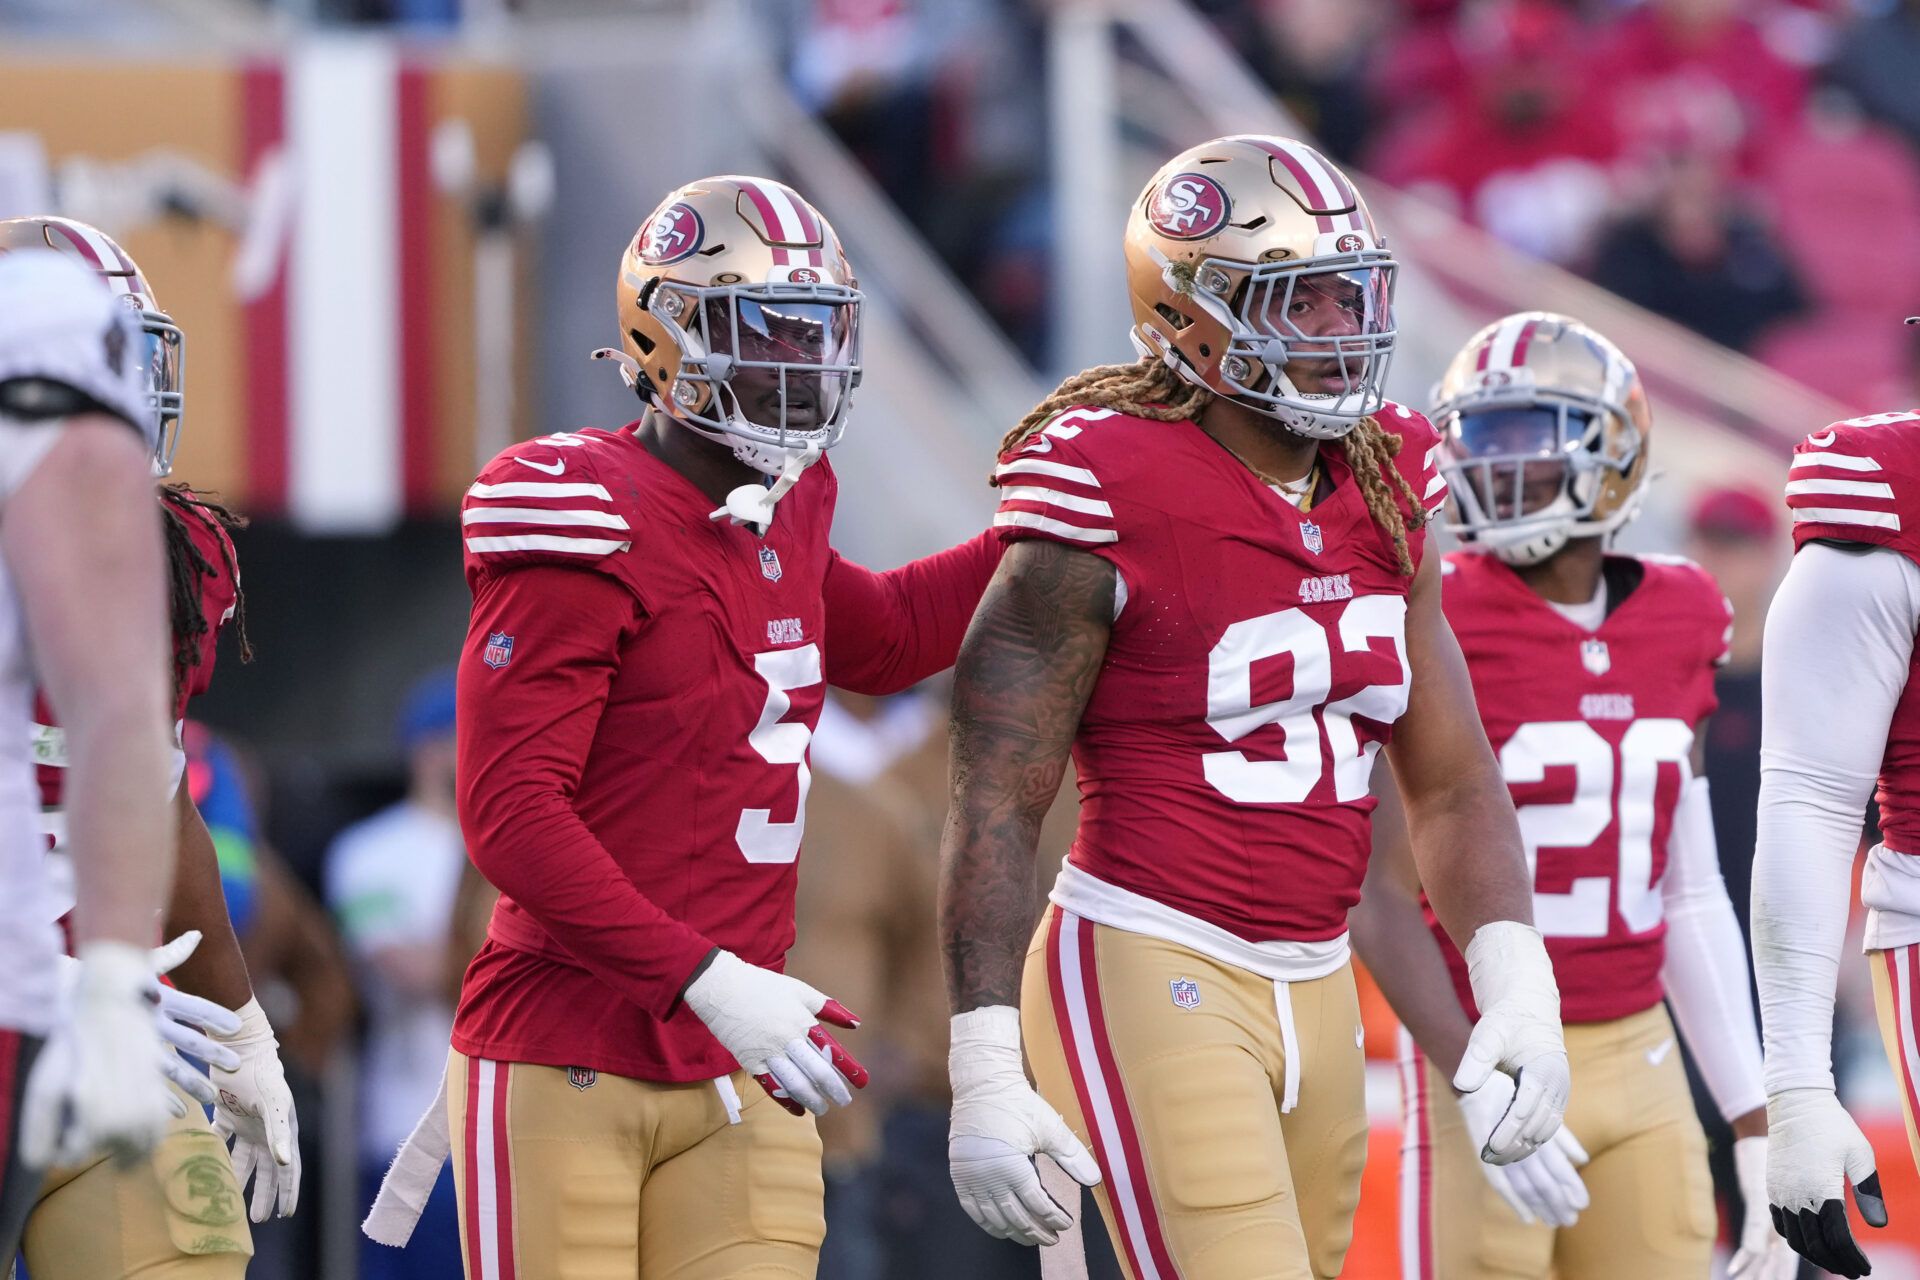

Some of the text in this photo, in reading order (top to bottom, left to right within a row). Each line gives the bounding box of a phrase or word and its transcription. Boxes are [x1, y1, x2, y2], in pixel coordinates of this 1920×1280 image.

[1298, 573, 1354, 603] 49ERS
[766, 617, 803, 644] 49ERS
[487, 645, 508, 664] NFL
[1202, 595, 1412, 803] 92
[735, 643, 822, 864] 5
[1499, 718, 1694, 936] 20
[1176, 990, 1197, 1004] NFL
[573, 1067, 593, 1084] NFL
